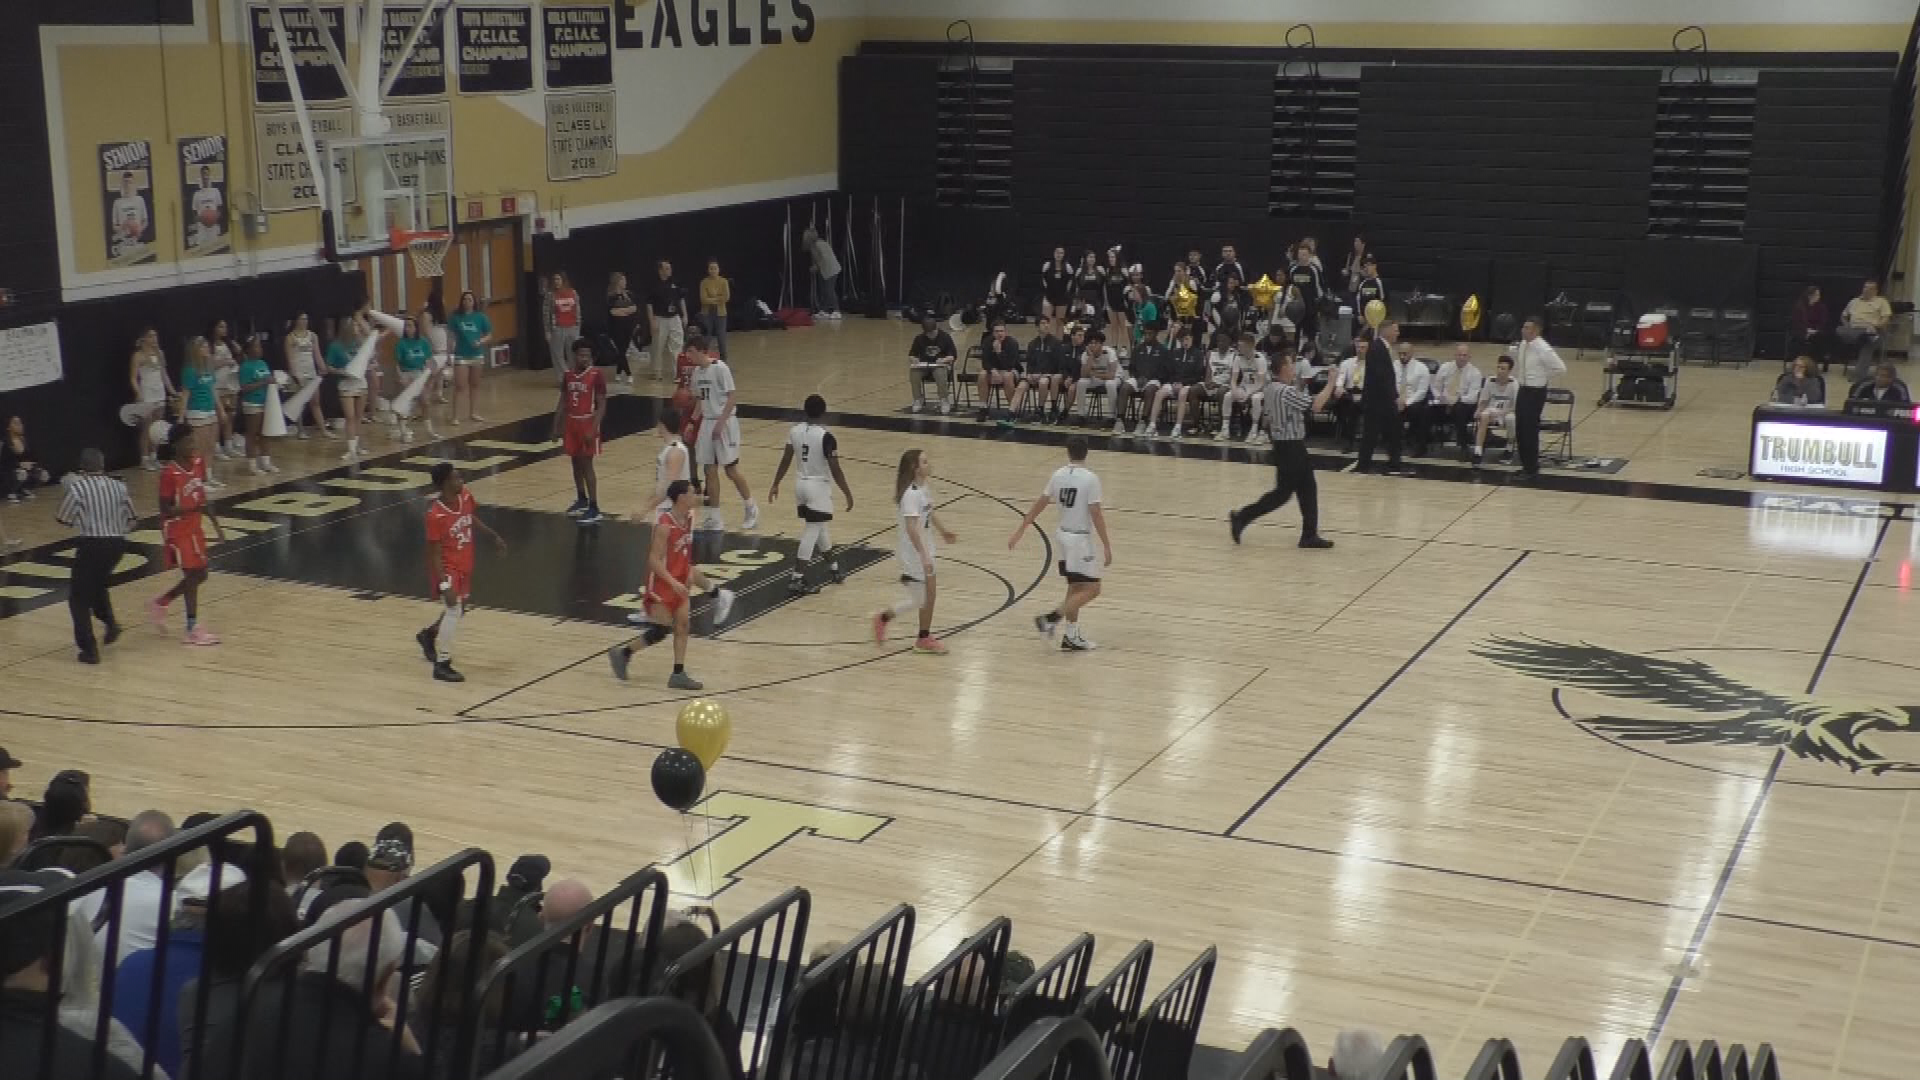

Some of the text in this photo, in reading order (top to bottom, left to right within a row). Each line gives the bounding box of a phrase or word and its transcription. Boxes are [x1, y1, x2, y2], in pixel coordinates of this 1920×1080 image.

[616, 0, 815, 48] EAGLES
[556, 119, 590, 133] CLASS
[102, 140, 149, 171] SENIOR
[182, 135, 225, 164] SENIOR
[267, 162, 295, 181] STATE
[801, 443, 810, 463] 2
[1760, 434, 1878, 470] TRUMBULL
[1059, 487, 1078, 509] 40
